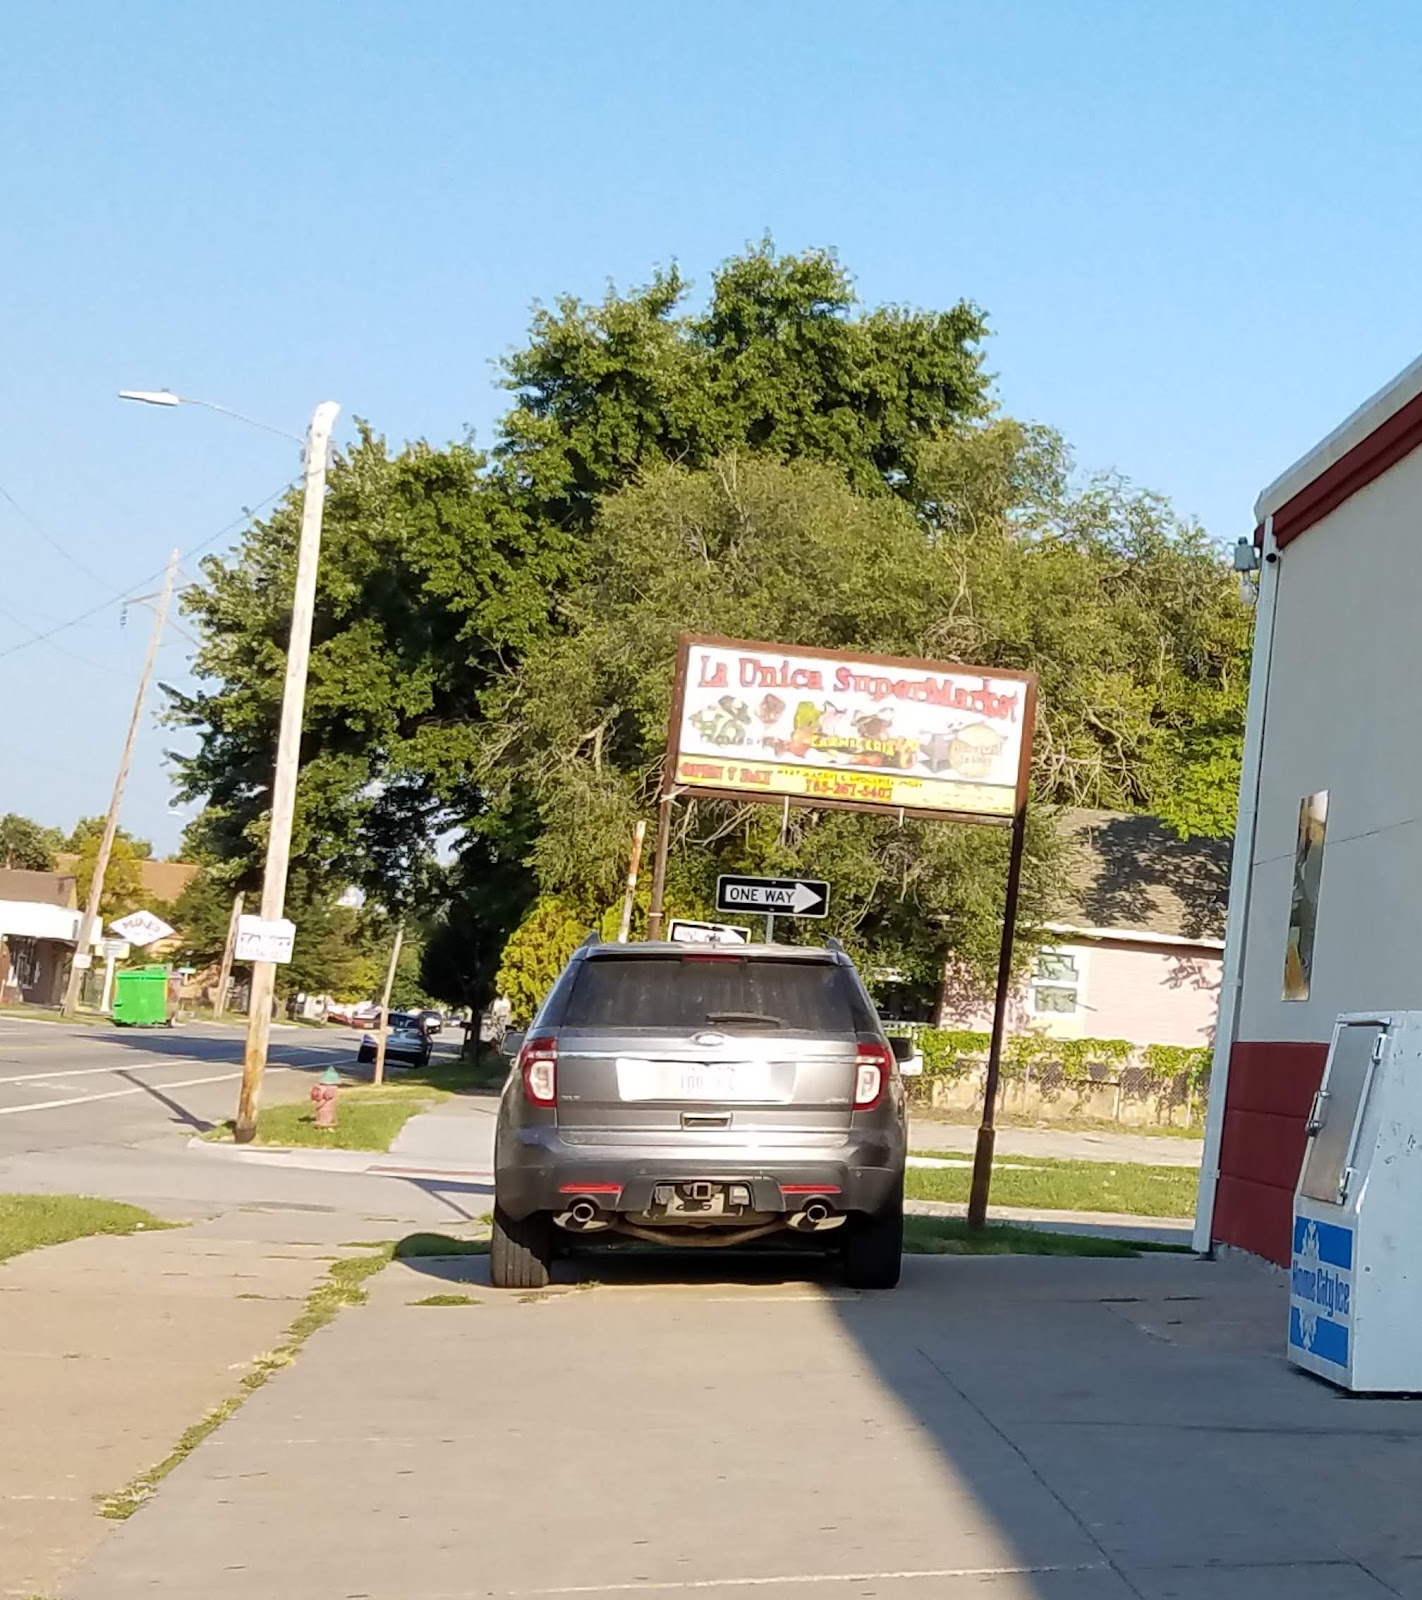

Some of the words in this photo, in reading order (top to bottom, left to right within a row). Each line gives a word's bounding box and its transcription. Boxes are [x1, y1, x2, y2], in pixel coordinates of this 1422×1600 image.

[698, 655, 728, 688] La
[738, 657, 824, 691] Unica
[730, 887, 760, 902] ONE
[765, 890, 795, 904] WAY
[1317, 1267, 1335, 1317] City
[1335, 1273, 1350, 1315] Ice
